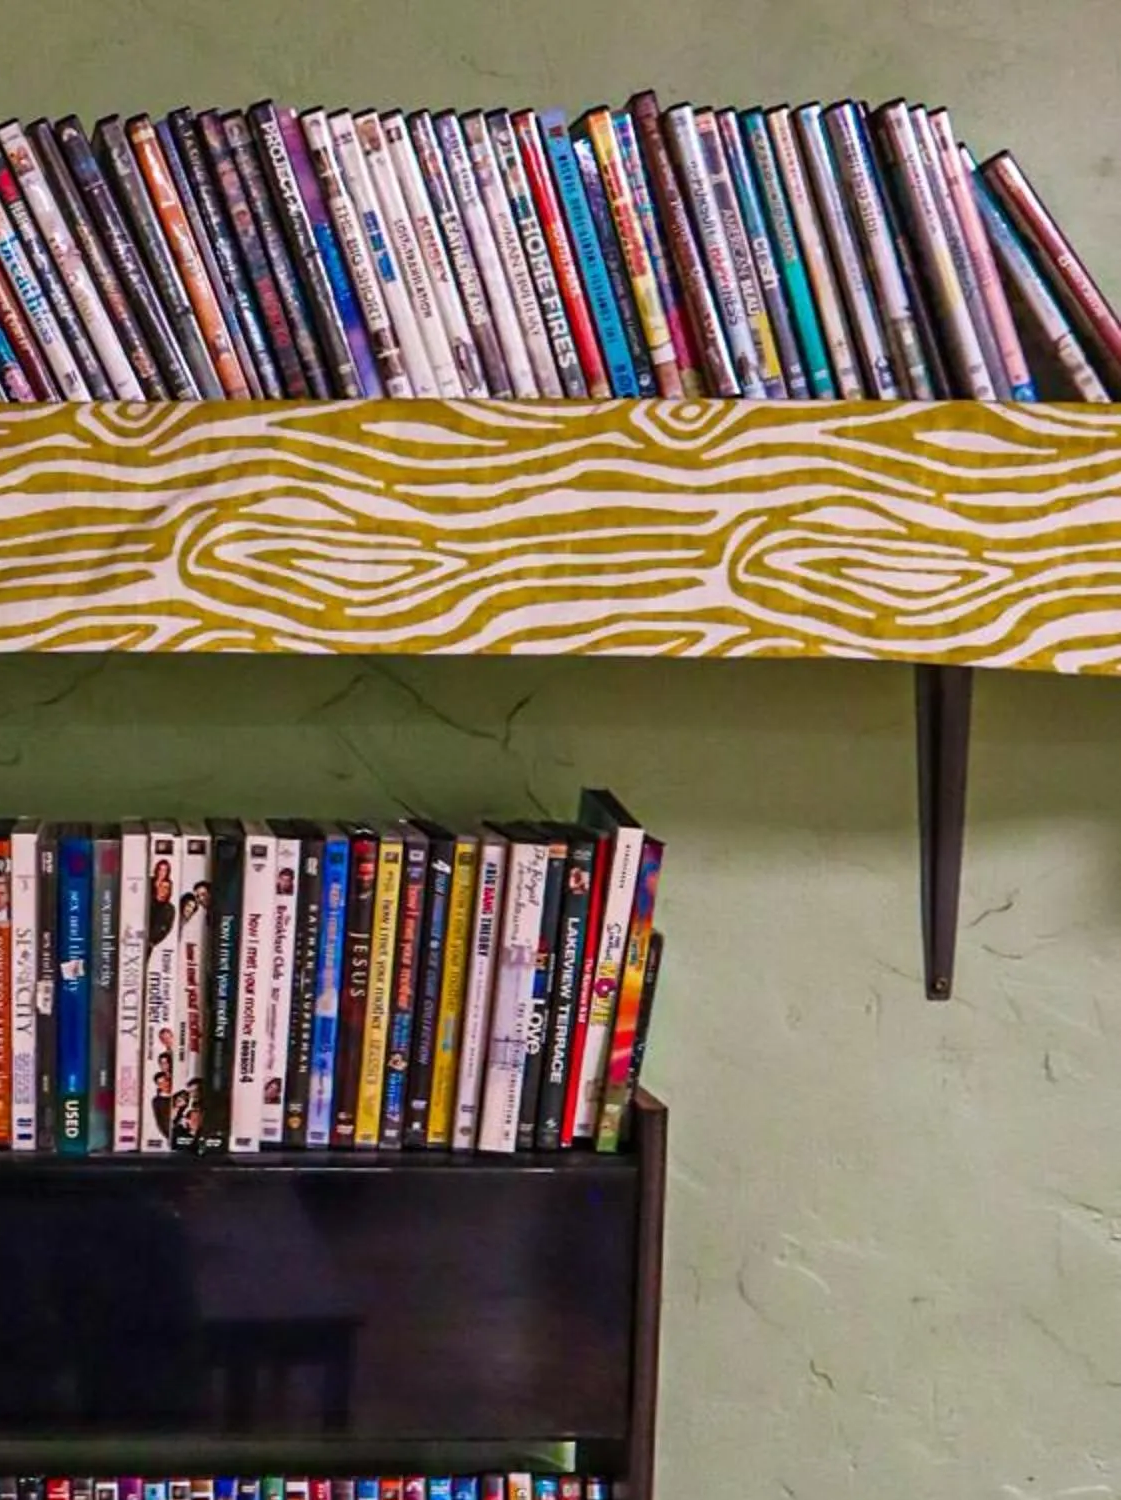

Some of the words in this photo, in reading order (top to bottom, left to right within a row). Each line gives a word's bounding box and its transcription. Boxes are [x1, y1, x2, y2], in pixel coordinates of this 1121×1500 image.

[344, 235, 365, 265] BIG
[354, 266, 384, 324] SHORT
[518, 214, 557, 293] HOME
[543, 293, 578, 370] FIRES
[432, 859, 451, 874] 4
[220, 915, 233, 937] how
[248, 913, 261, 936] how
[273, 905, 287, 953] Breakfast
[381, 900, 393, 922] how
[305, 904, 317, 969] BATMAN
[379, 937, 391, 956] met
[477, 918, 493, 957] THEORY
[219, 948, 231, 971] met
[247, 948, 259, 969] met
[272, 956, 284, 980] Club
[349, 932, 369, 998] JESUS
[560, 917, 580, 998] LAKEVIEW
[149, 972, 163, 1025] mother
[242, 972, 257, 994] your
[15, 987, 31, 1036] CITY
[121, 990, 140, 1039] CITY
[215, 1000, 229, 1038] mother
[242, 998, 257, 1036] mother
[371, 987, 386, 1030] mother
[527, 1000, 546, 1055] Love
[299, 993, 315, 1074] SUPERMAN
[550, 1004, 571, 1084] TERRACE
[239, 1075, 253, 1083] 4
[65, 1100, 79, 1138] USED
